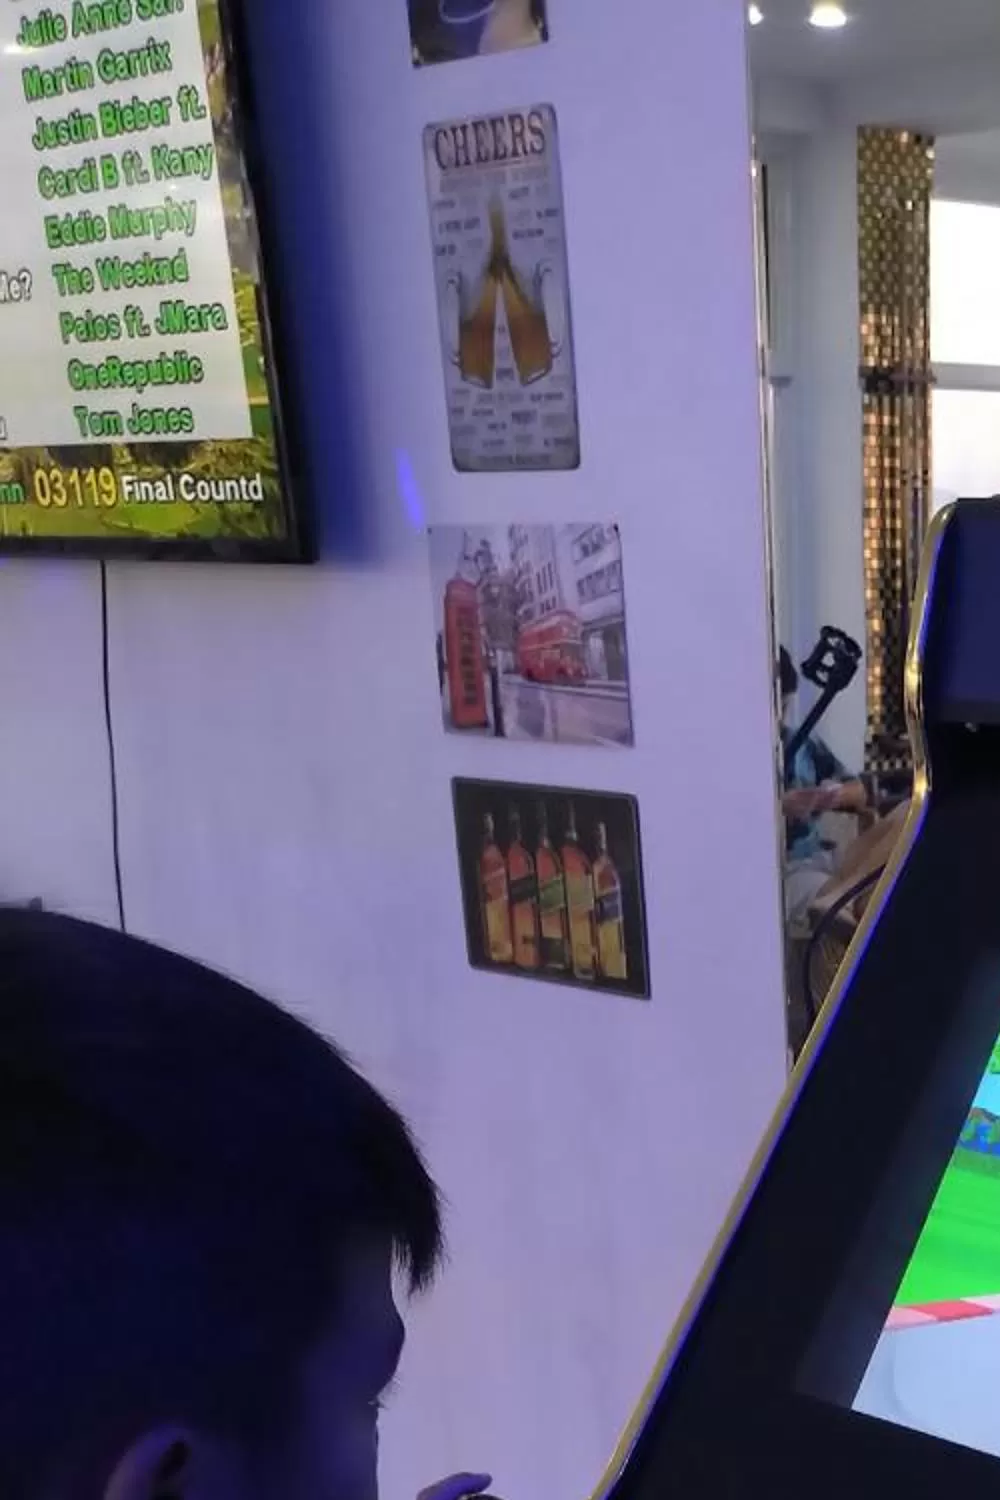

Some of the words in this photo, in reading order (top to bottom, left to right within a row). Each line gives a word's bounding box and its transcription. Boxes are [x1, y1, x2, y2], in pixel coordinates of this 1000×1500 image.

[16, 8, 68, 47] Julie
[72, 0, 132, 38] Anne
[22, 56, 95, 101] Martin
[97, 36, 172, 84] Garrix
[32, 108, 98, 150] Justin
[98, 96, 172, 137] Bieber
[177, 85, 206, 122] ft.
[434, 110, 546, 171] CHEERS
[38, 157, 99, 200] Cardi
[101, 153, 120, 189] B
[151, 143, 214, 180] Kany
[44, 209, 107, 249] Eddie
[107, 196, 196, 240] Murphy
[52, 262, 95, 297] The
[95, 247, 189, 291] Weeknd
[123, 304, 152, 338] ft.
[67, 350, 204, 394] OneRepublic
[73, 405, 123, 437] Tom
[127, 403, 194, 435] Jones
[34, 466, 119, 507] 03119
[120, 475, 175, 502] Final
[178, 472, 265, 502] Countd
